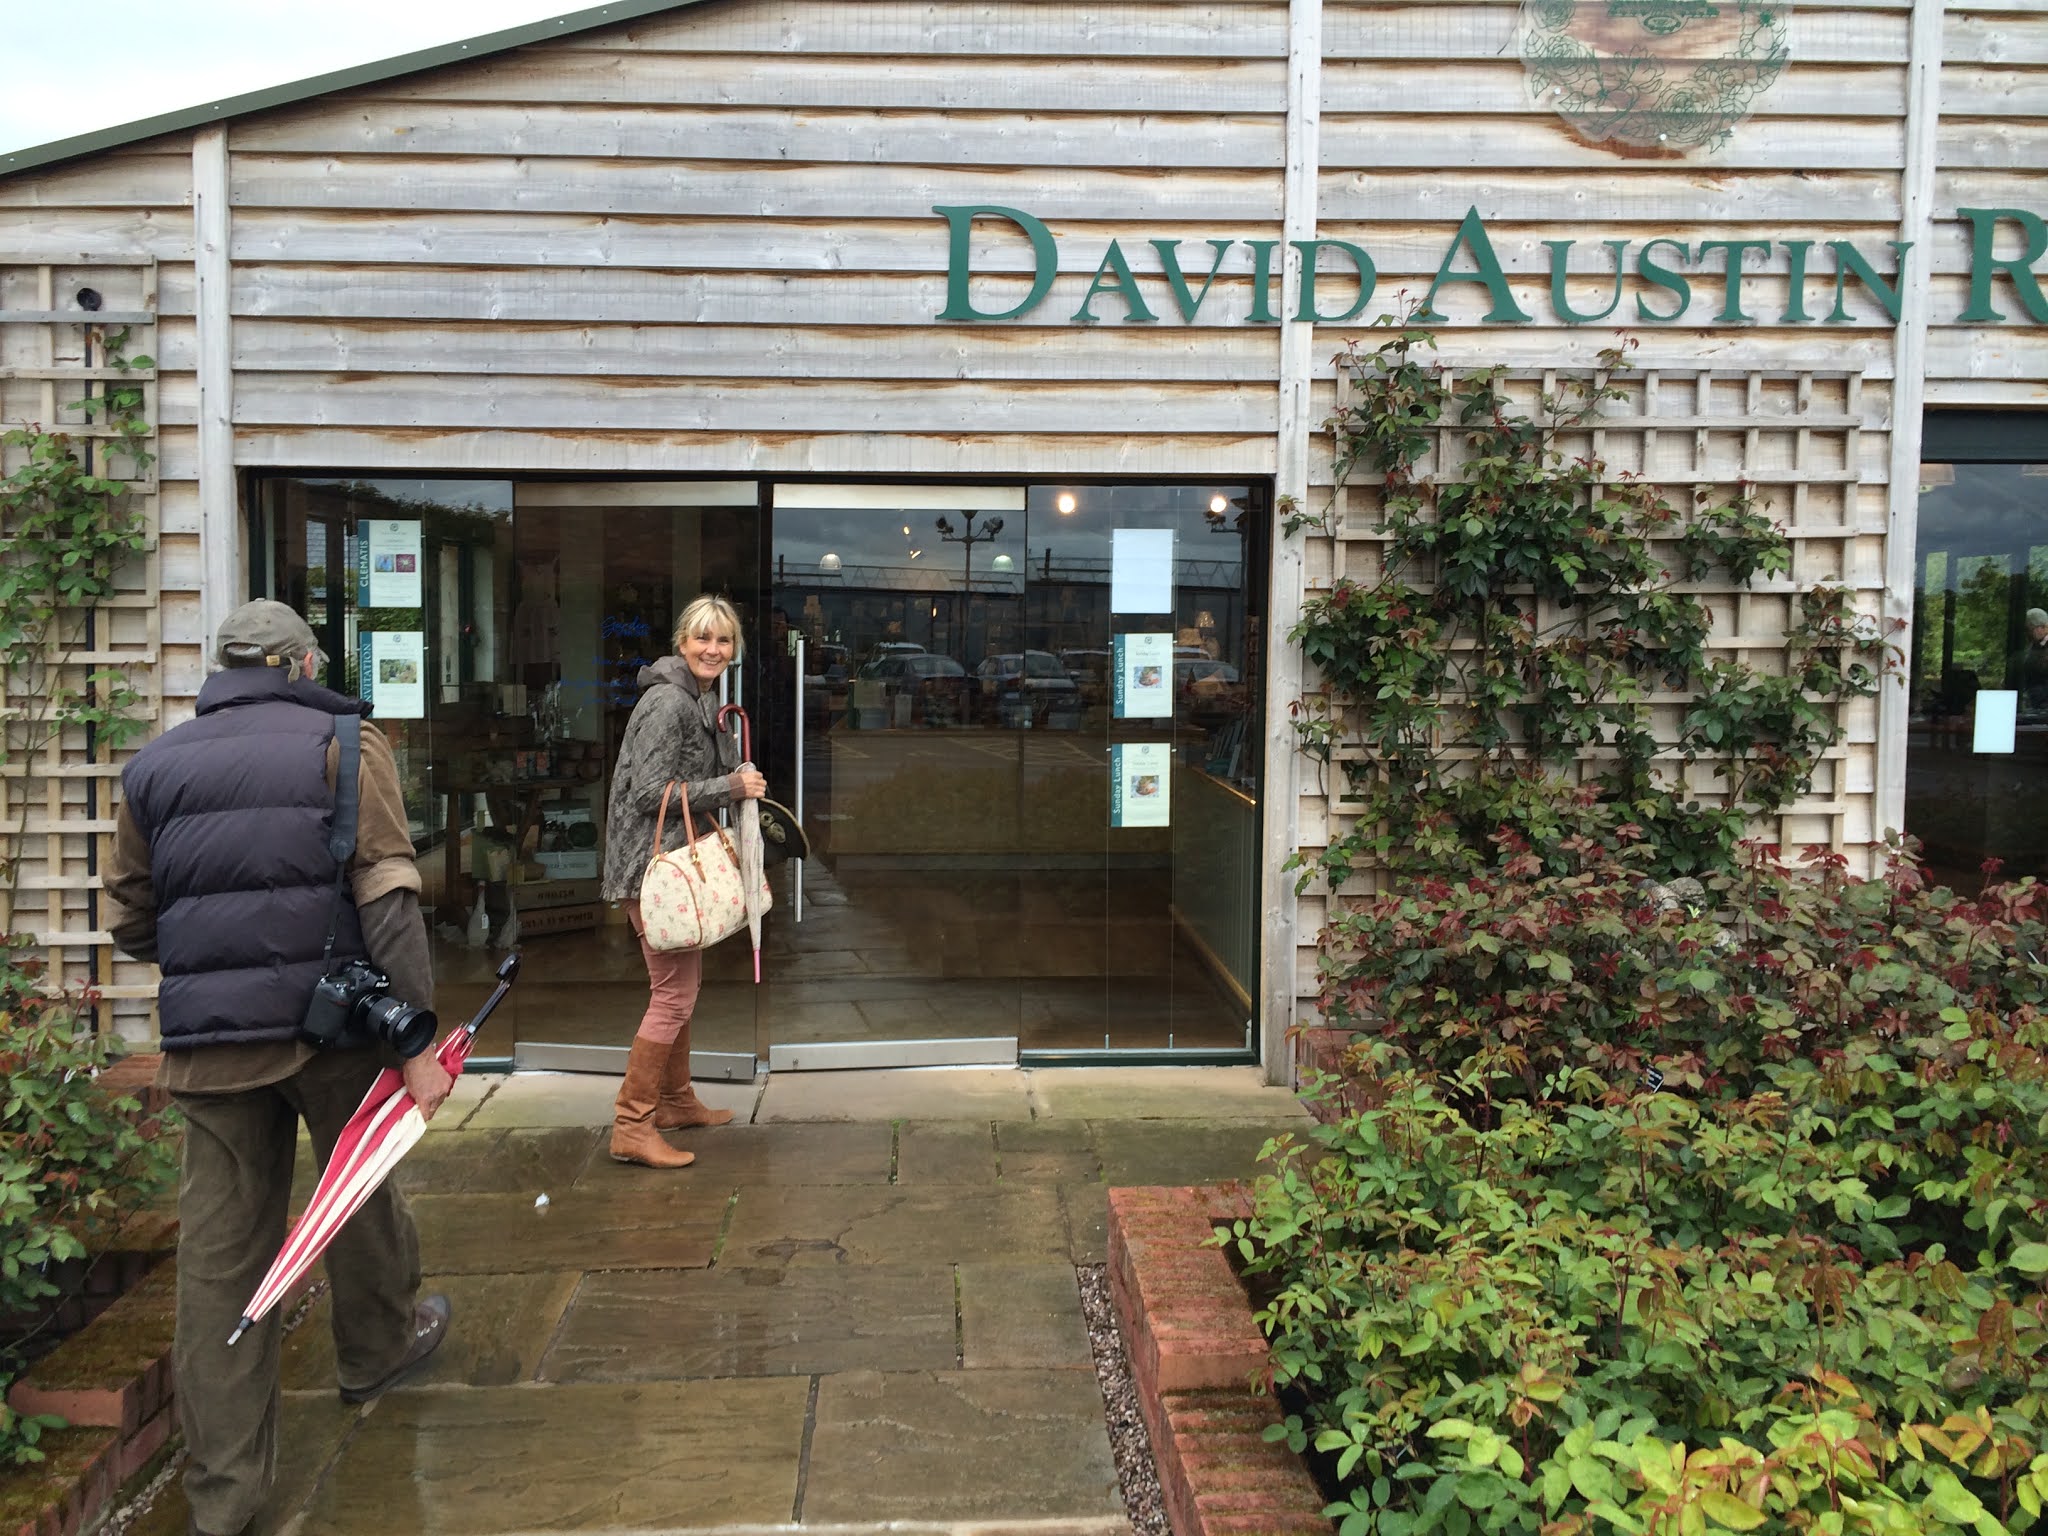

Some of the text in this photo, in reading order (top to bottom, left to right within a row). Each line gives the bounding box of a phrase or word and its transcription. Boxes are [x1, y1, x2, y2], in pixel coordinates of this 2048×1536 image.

[932, 205, 1377, 323] DAVID
[1409, 204, 1915, 323] AUSTIN
[359, 540, 369, 587] CLEMATIS
[362, 643, 372, 703] NVITATION
[1115, 647, 1125, 705] Sunday Lunch
[1113, 757, 1122, 814] Sunday Lunch
